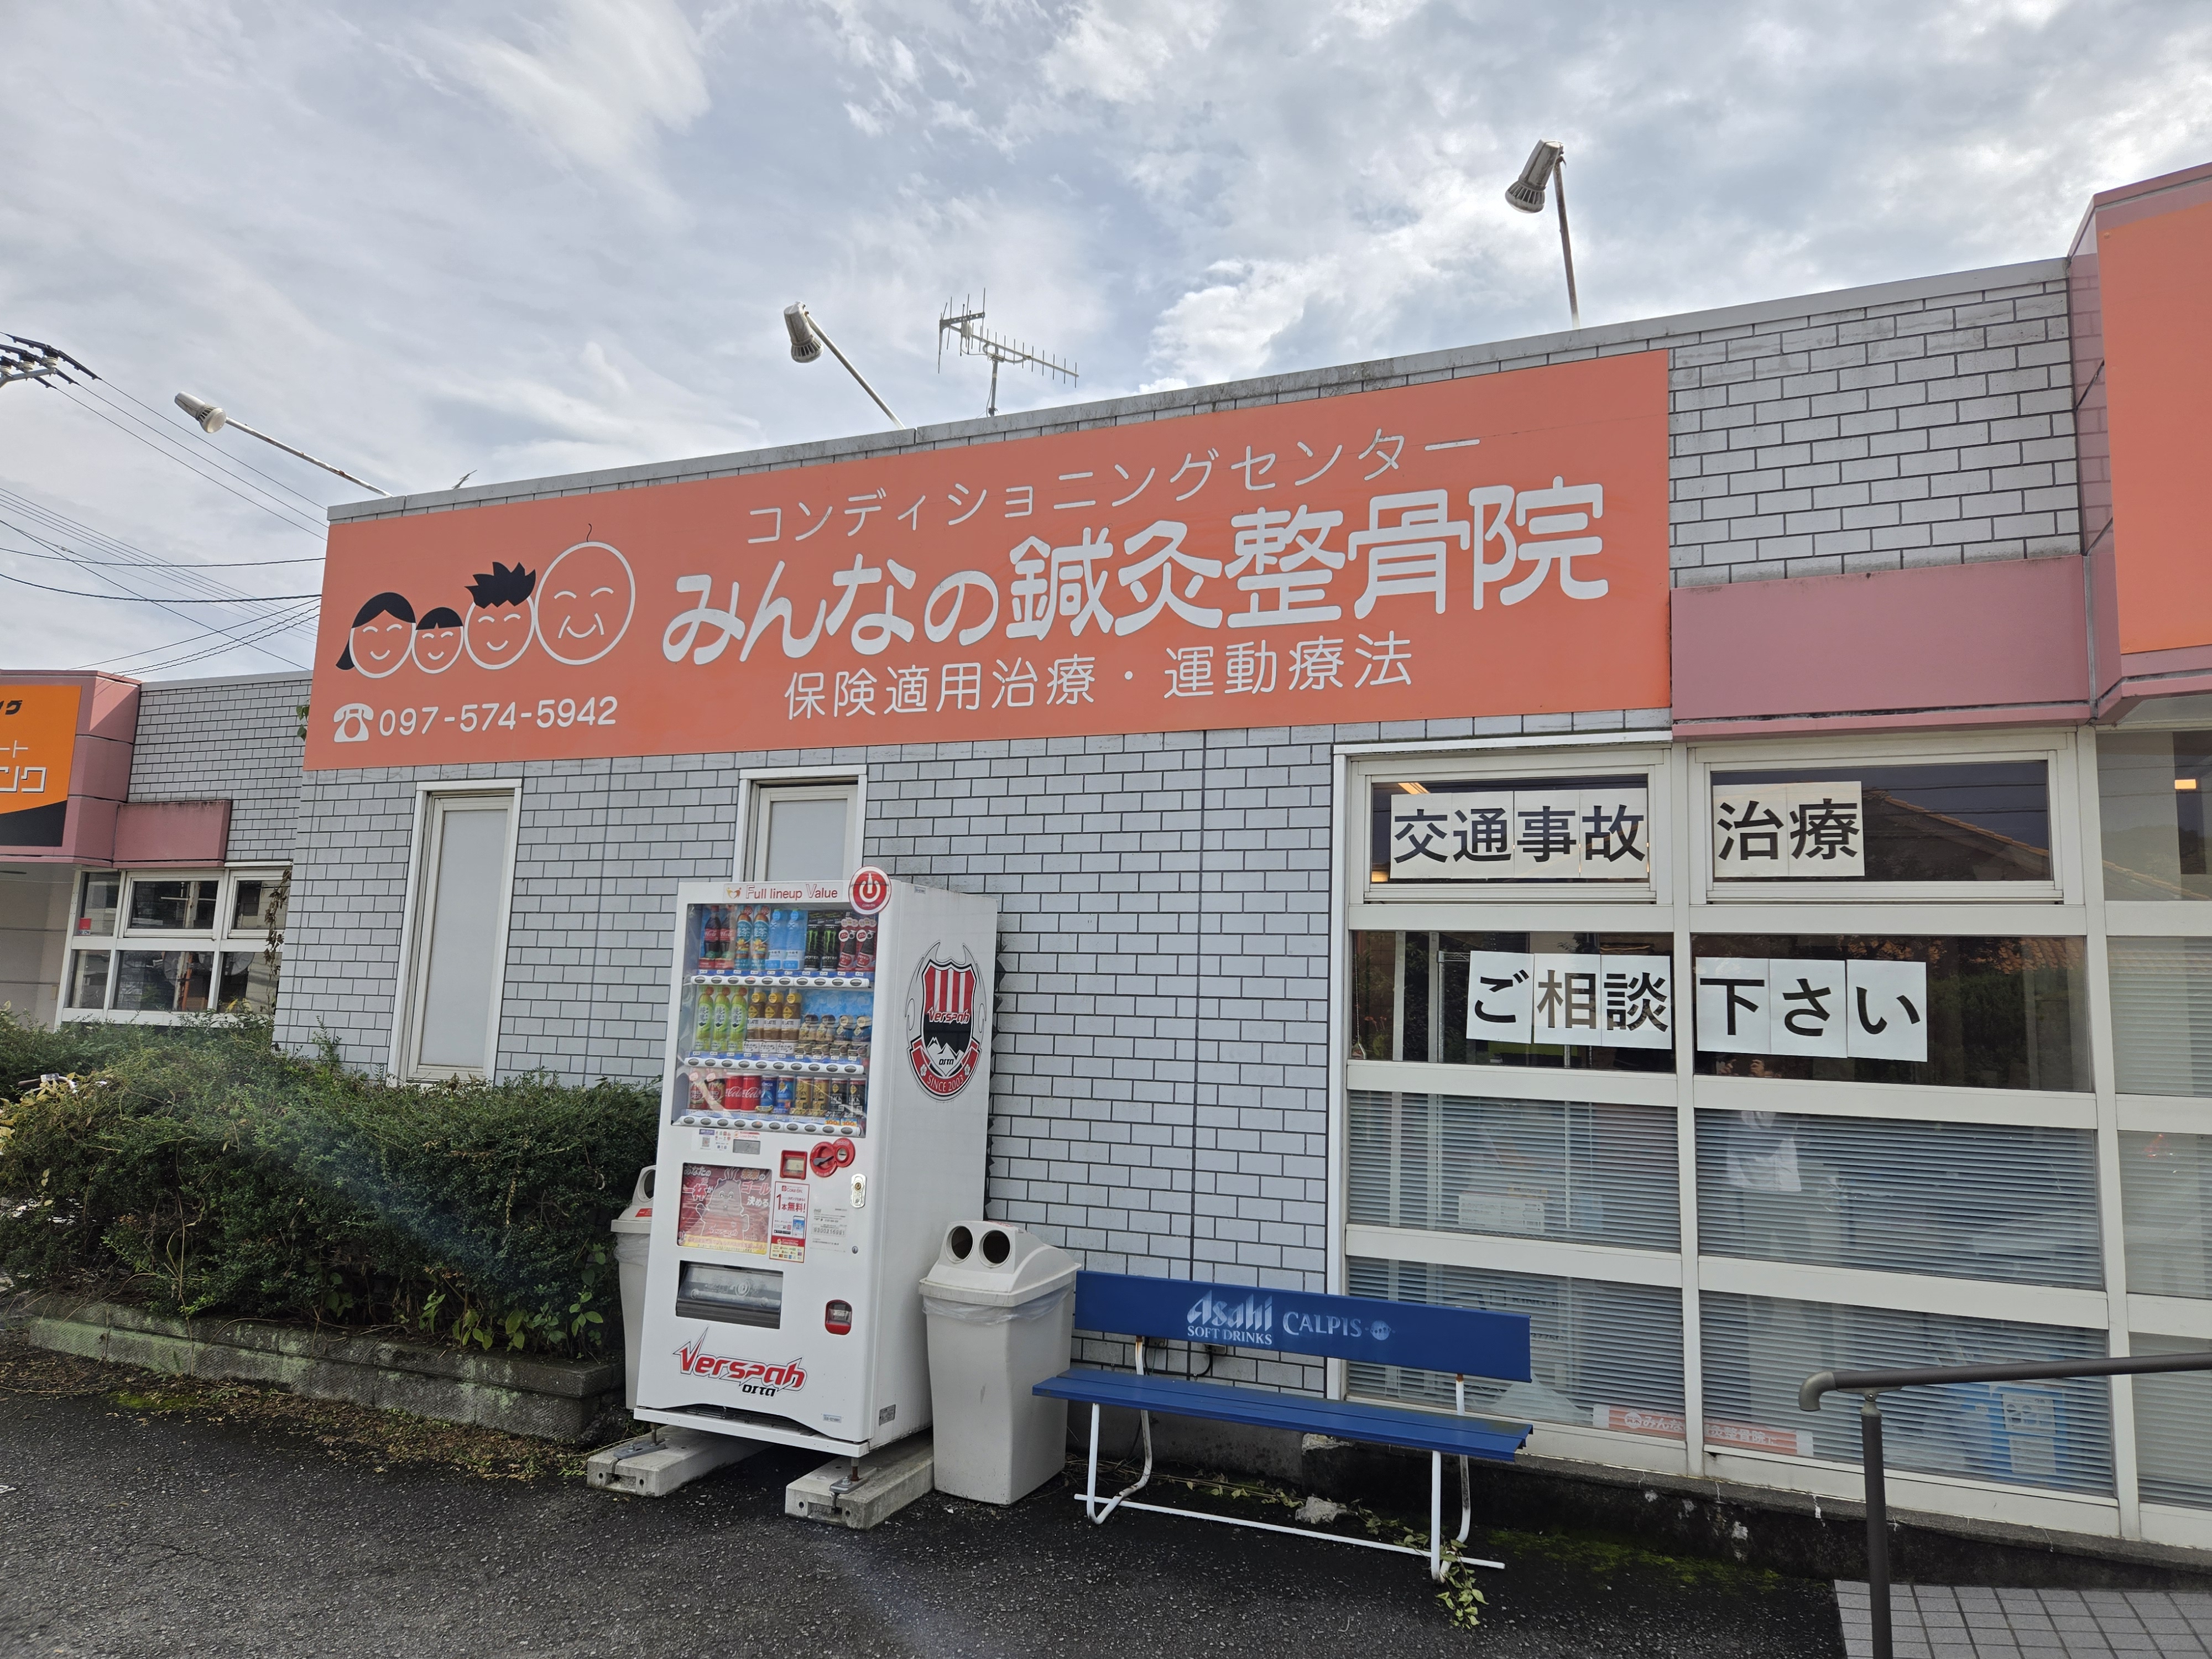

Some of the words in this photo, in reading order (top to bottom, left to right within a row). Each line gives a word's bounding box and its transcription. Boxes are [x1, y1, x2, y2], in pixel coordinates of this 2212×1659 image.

[747, 427, 1480, 544] コンディショニングセンター
[663, 476, 1609, 665] みんなの鍼灸整骨院
[784, 630, 1413, 720] 保険適用治療・運動療法
[379, 696, 618, 736] 097-574-5942
[1394, 804, 1646, 863] 交通事故
[1718, 798, 1860, 860] 治療
[745, 885, 766, 899] Full
[770, 888, 802, 900] lineup
[806, 884, 838, 899] Value
[1474, 969, 1668, 1032] ご相談
[1700, 978, 1920, 1036] 下さい
[927, 1074, 947, 1092] SINCE
[948, 1074, 964, 1091] 2003
[1187, 1289, 1272, 1332] Asahi
[1282, 1311, 1361, 1338] CALPIS
[1187, 1325, 1220, 1338] SOFT
[1222, 1329, 1272, 1345] DRINKS
